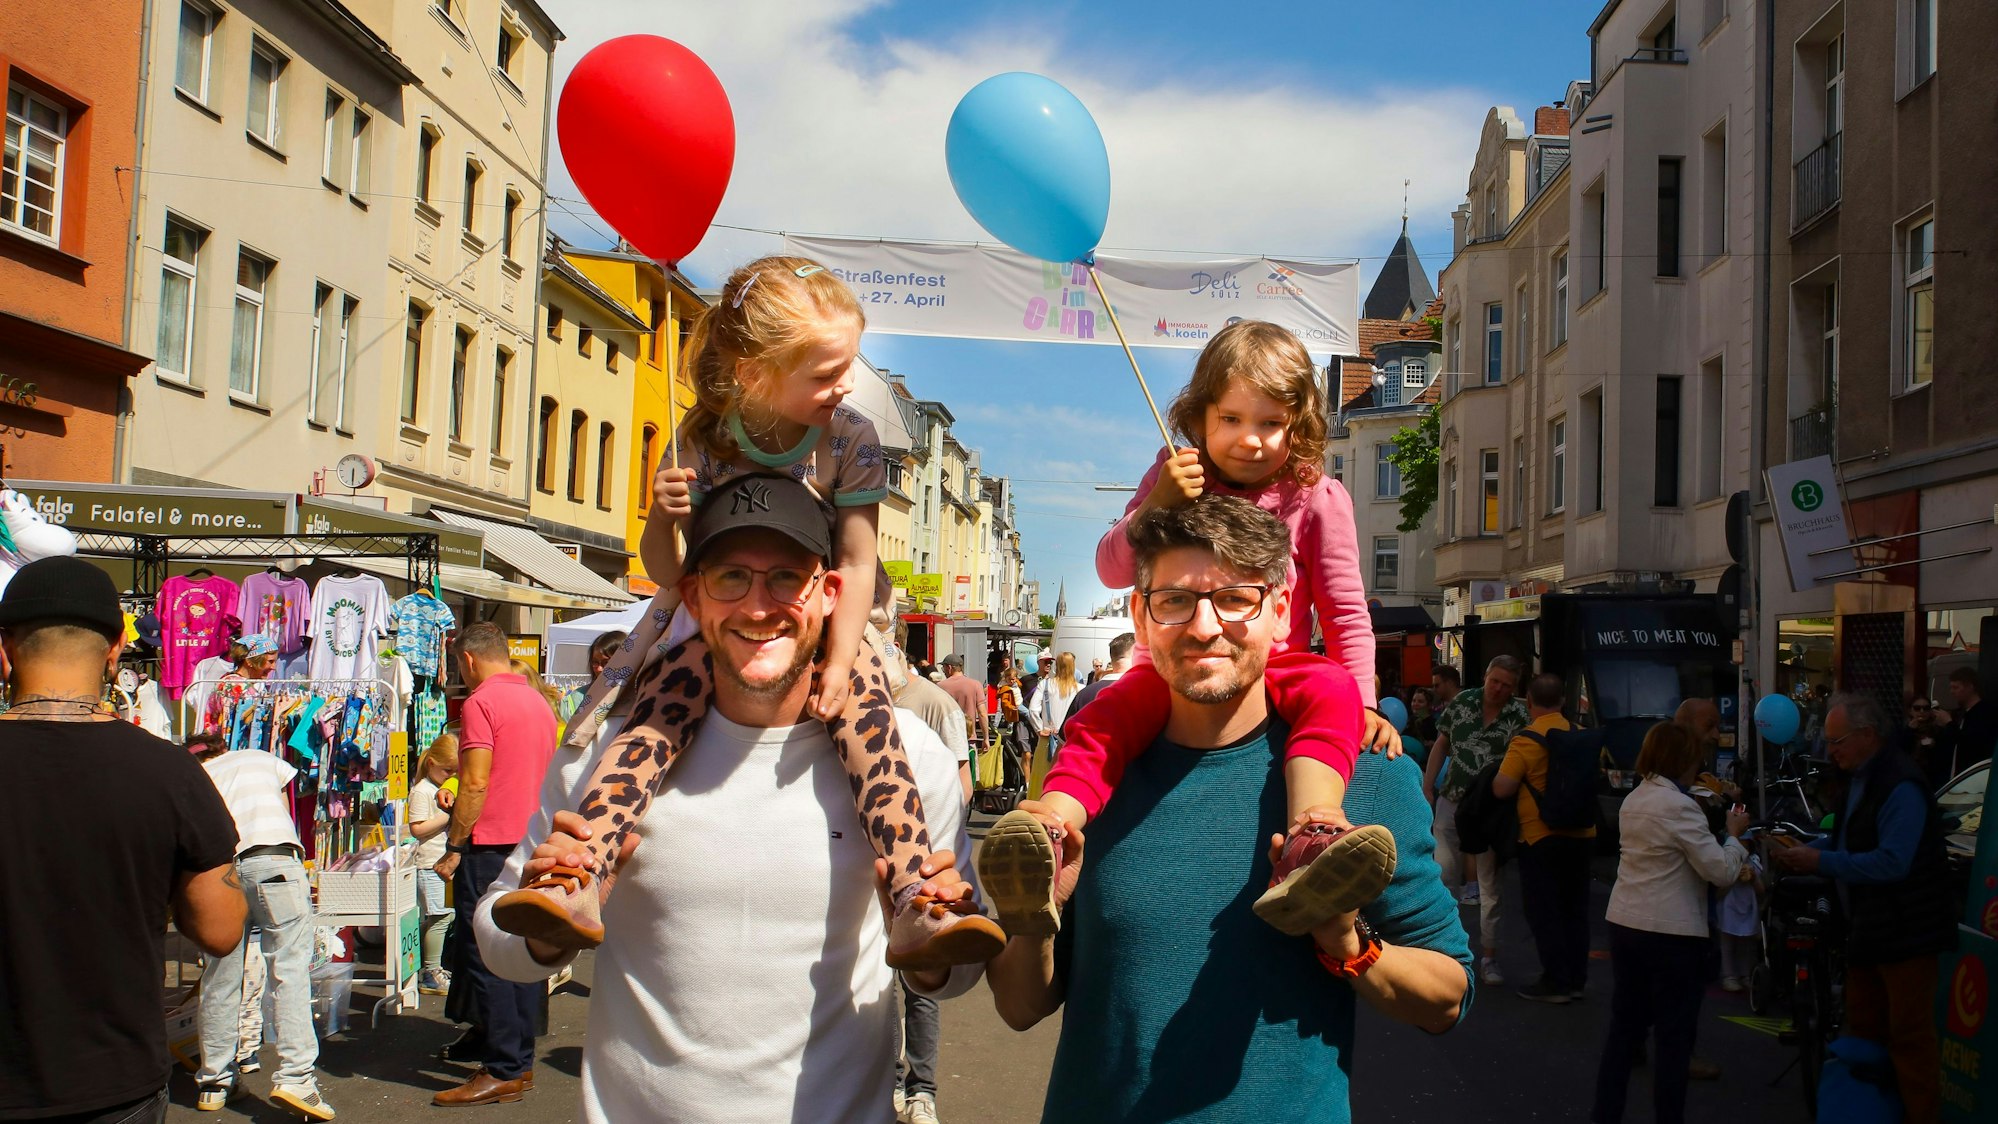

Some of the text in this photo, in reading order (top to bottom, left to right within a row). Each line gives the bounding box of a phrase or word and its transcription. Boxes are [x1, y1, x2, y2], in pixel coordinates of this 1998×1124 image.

[831, 268, 946, 288] Straßenfest
[1190, 271, 1241, 295] Deli
[1062, 287, 1086, 307] im
[1211, 291, 1240, 299] SÜLZ
[1256, 283, 1303, 296] Carrée
[904, 293, 945, 308] April
[1306, 327, 1338, 340] KÖLN
[36, 495, 74, 514] fala
[90, 504, 262, 529] Falafel & more...
[313, 513, 330, 532] fala
[1787, 513, 1840, 531] BRUCHHAUS
[326, 598, 366, 618] MOOMIN
[1597, 629, 1720, 647] NICE TO MEAT YOU.
[1720, 697, 1732, 714] P
[391, 754, 406, 774] 10€
[402, 927, 419, 956] 20€
[1941, 1037, 1983, 1081] REWE
